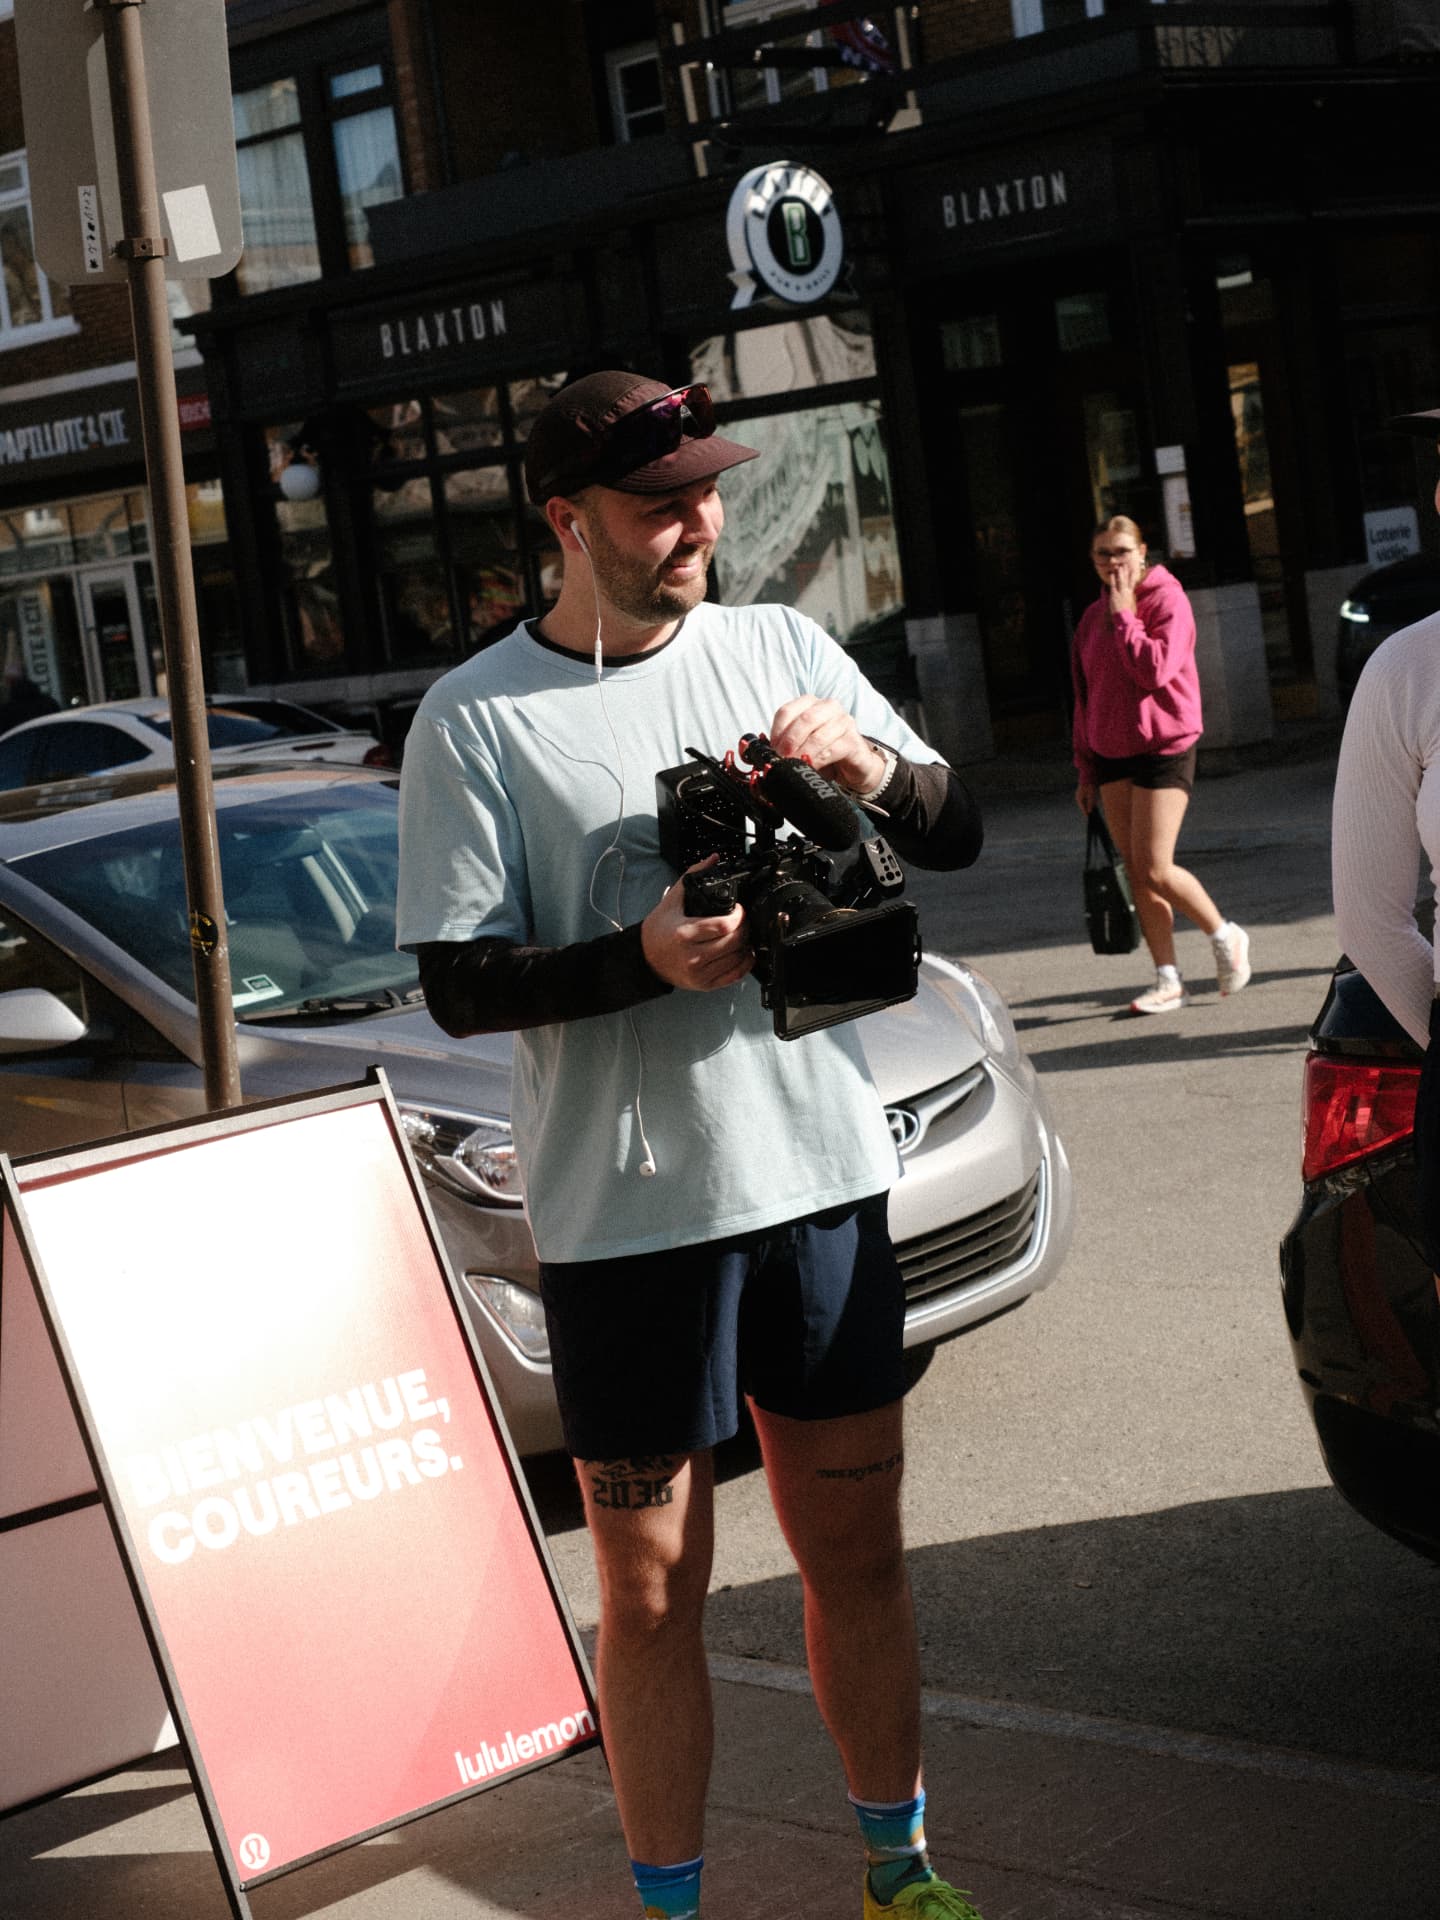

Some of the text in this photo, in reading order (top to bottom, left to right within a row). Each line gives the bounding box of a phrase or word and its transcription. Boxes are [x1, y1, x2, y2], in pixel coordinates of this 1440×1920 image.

[942, 169, 1067, 229] BLAXTON
[380, 299, 507, 358] BLAXTON
[126, 1368, 451, 1509] BIENVENUE,
[148, 1428, 464, 1564] COUREURS.
[454, 1708, 596, 1785] lululemon
